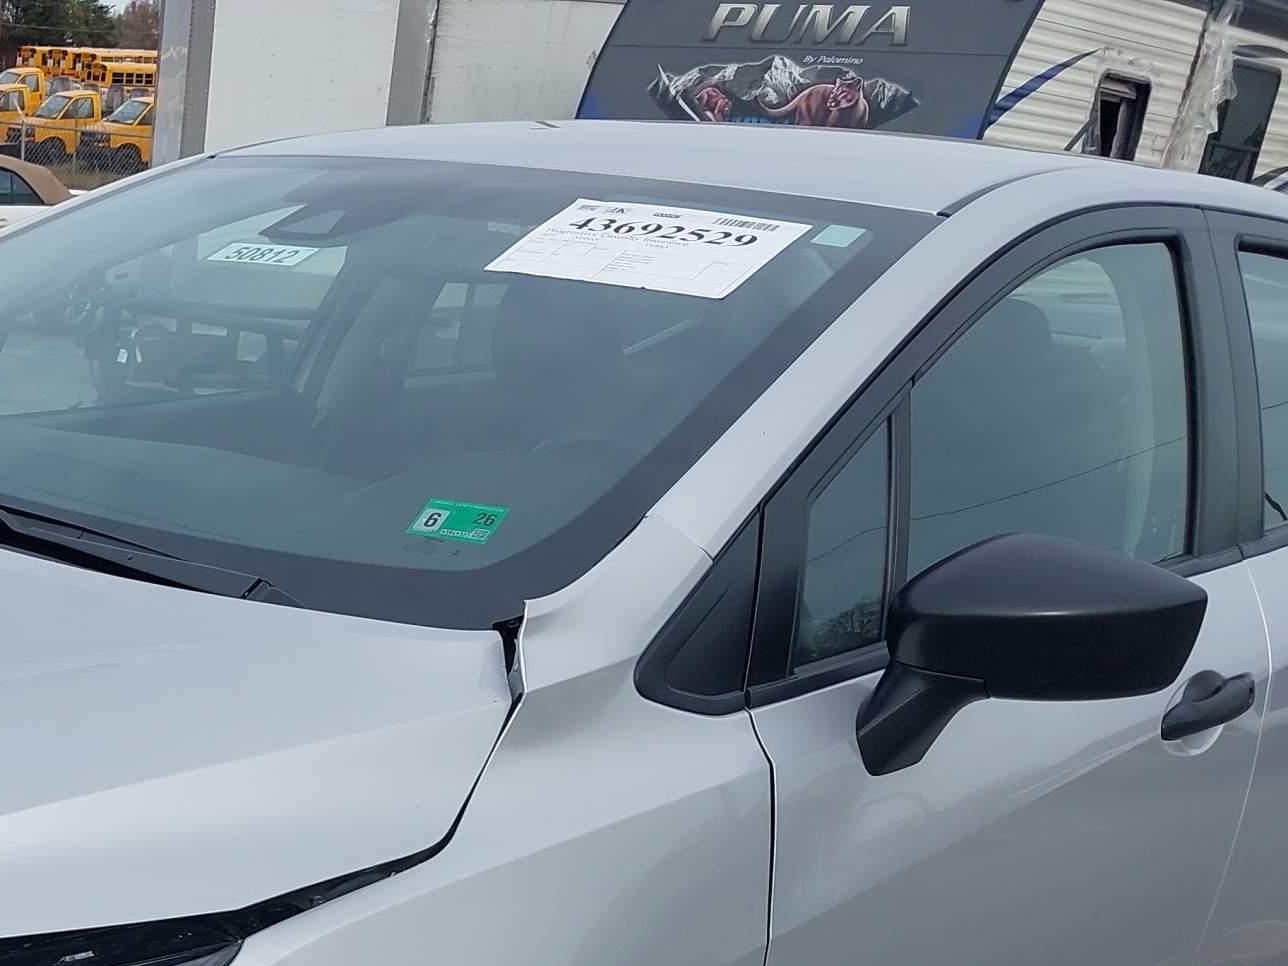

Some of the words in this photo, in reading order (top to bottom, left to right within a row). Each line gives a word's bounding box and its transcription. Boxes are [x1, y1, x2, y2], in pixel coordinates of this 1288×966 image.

[701, 3, 911, 46] PUMA
[802, 55, 818, 65] By
[817, 55, 864, 65] Palomino
[569, 216, 758, 248] 43692529
[223, 246, 300, 263] 50812
[423, 512, 442, 528] 6
[472, 512, 498, 527] 26
